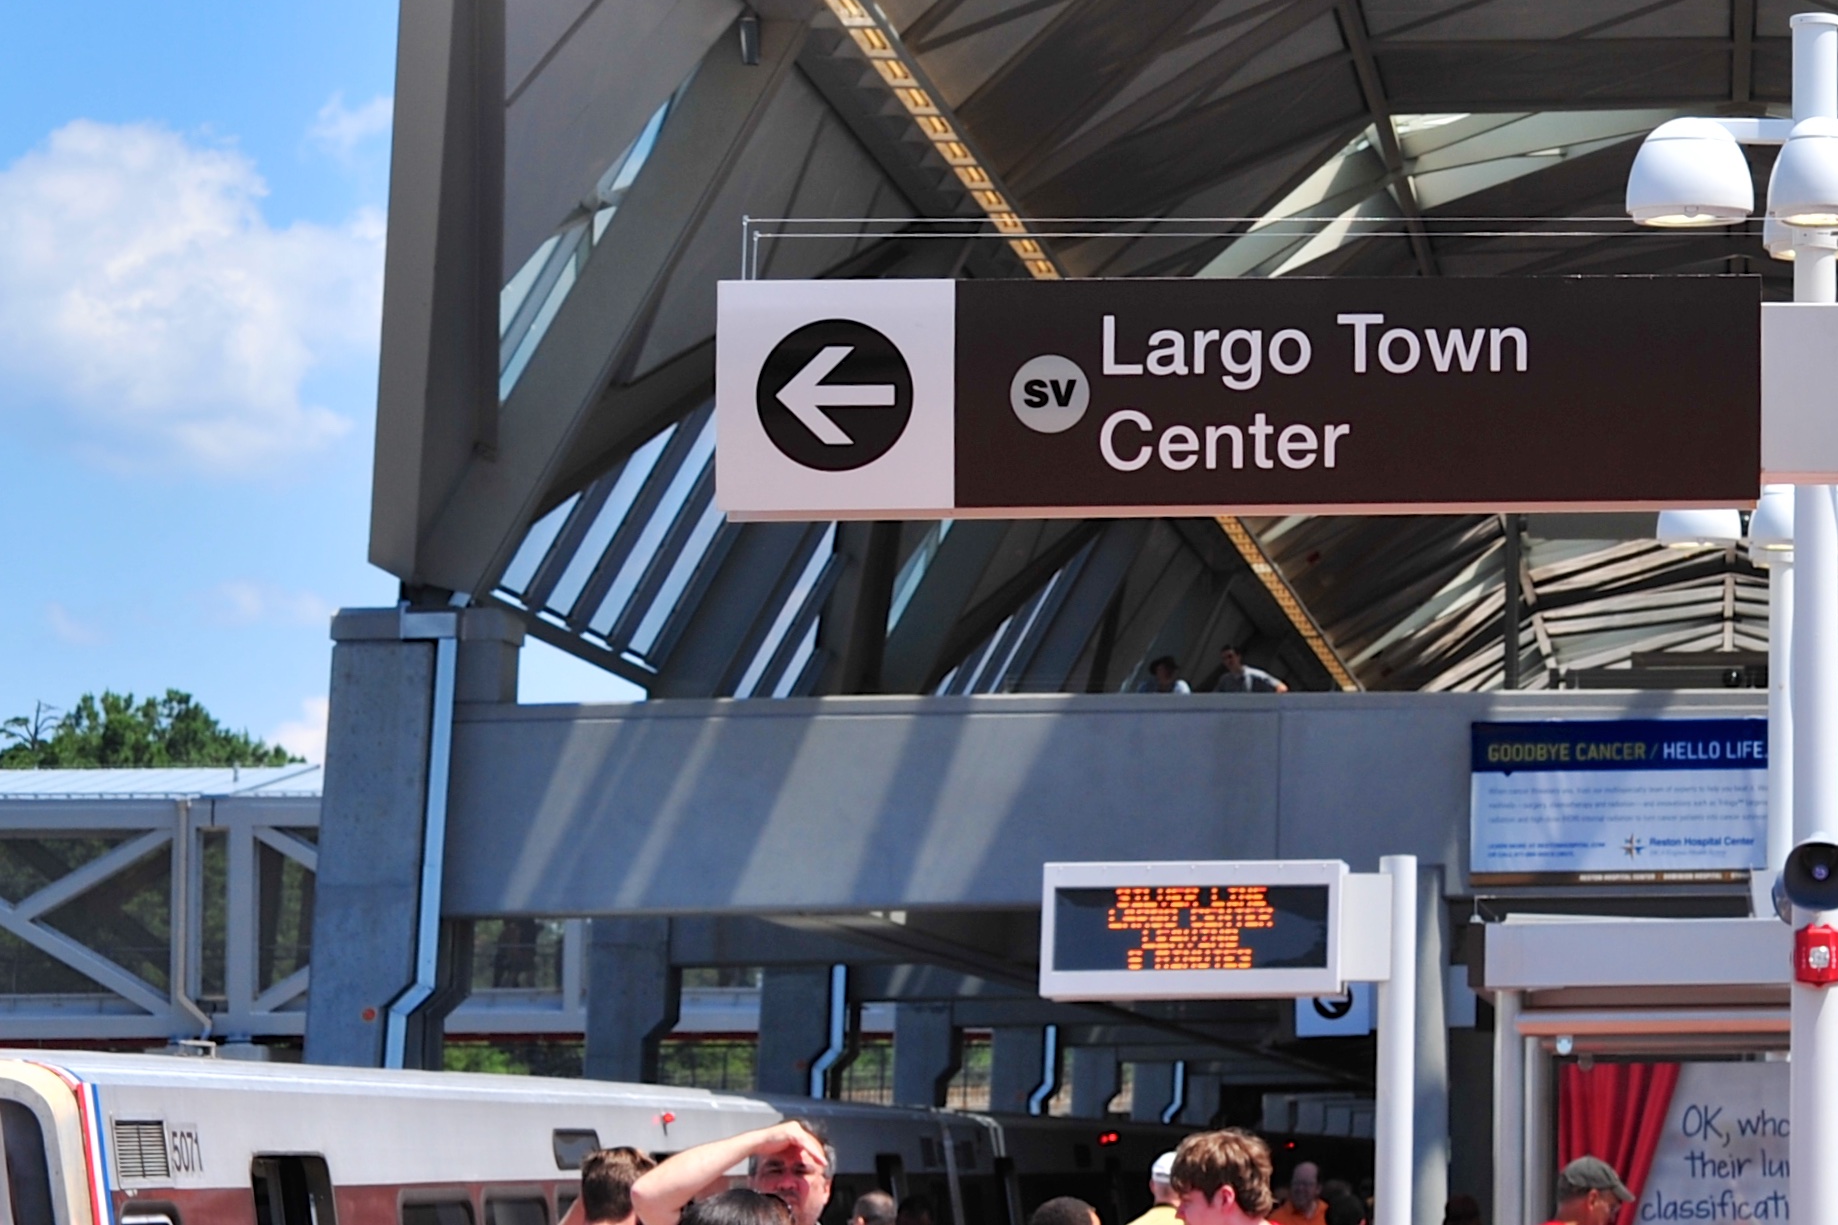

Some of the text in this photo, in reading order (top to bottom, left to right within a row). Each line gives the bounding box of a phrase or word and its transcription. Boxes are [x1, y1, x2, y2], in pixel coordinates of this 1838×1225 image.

[1101, 313, 1528, 390] Largo Town
[1023, 379, 1077, 408] SV
[1100, 410, 1350, 472] Center
[1487, 743, 1570, 762] GOODBYE
[1575, 742, 1646, 761] CANCER
[1663, 741, 1721, 760] HELLO
[1649, 835, 1755, 849] Reston Hospital Center
[1682, 1104, 1731, 1148] OK,
[172, 1130, 203, 1172] 5071
[1684, 1149, 1752, 1178] their
[1641, 1189, 1790, 1223] classificati
